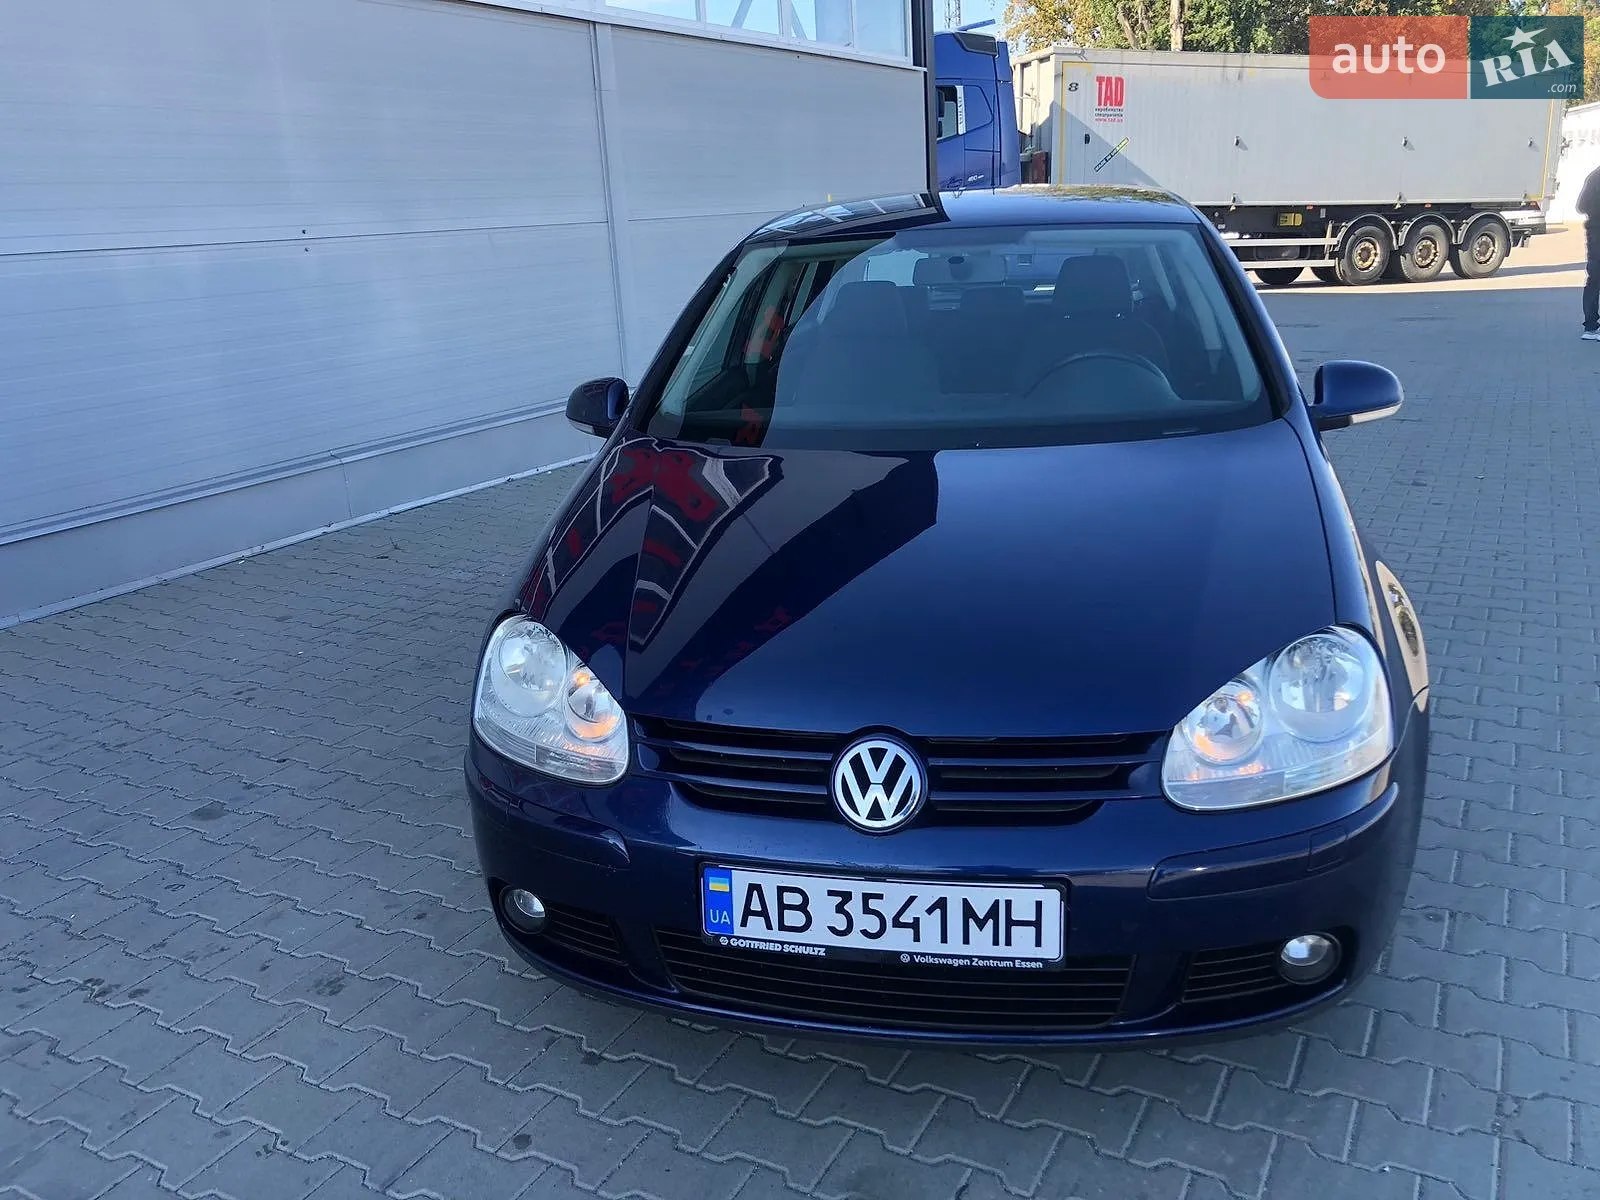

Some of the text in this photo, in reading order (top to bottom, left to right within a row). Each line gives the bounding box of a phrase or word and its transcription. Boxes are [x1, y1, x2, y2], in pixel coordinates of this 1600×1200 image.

[1096, 76, 1125, 107] TAD
[709, 908, 731, 925] UA
[740, 882, 1043, 948] AB 3541 MH
[730, 938, 826, 956] GOTTFRIED SCHULTZ
[913, 955, 970, 967] Volkswagen
[972, 957, 1013, 968] Zentrum
[1015, 959, 1043, 969] Essen
